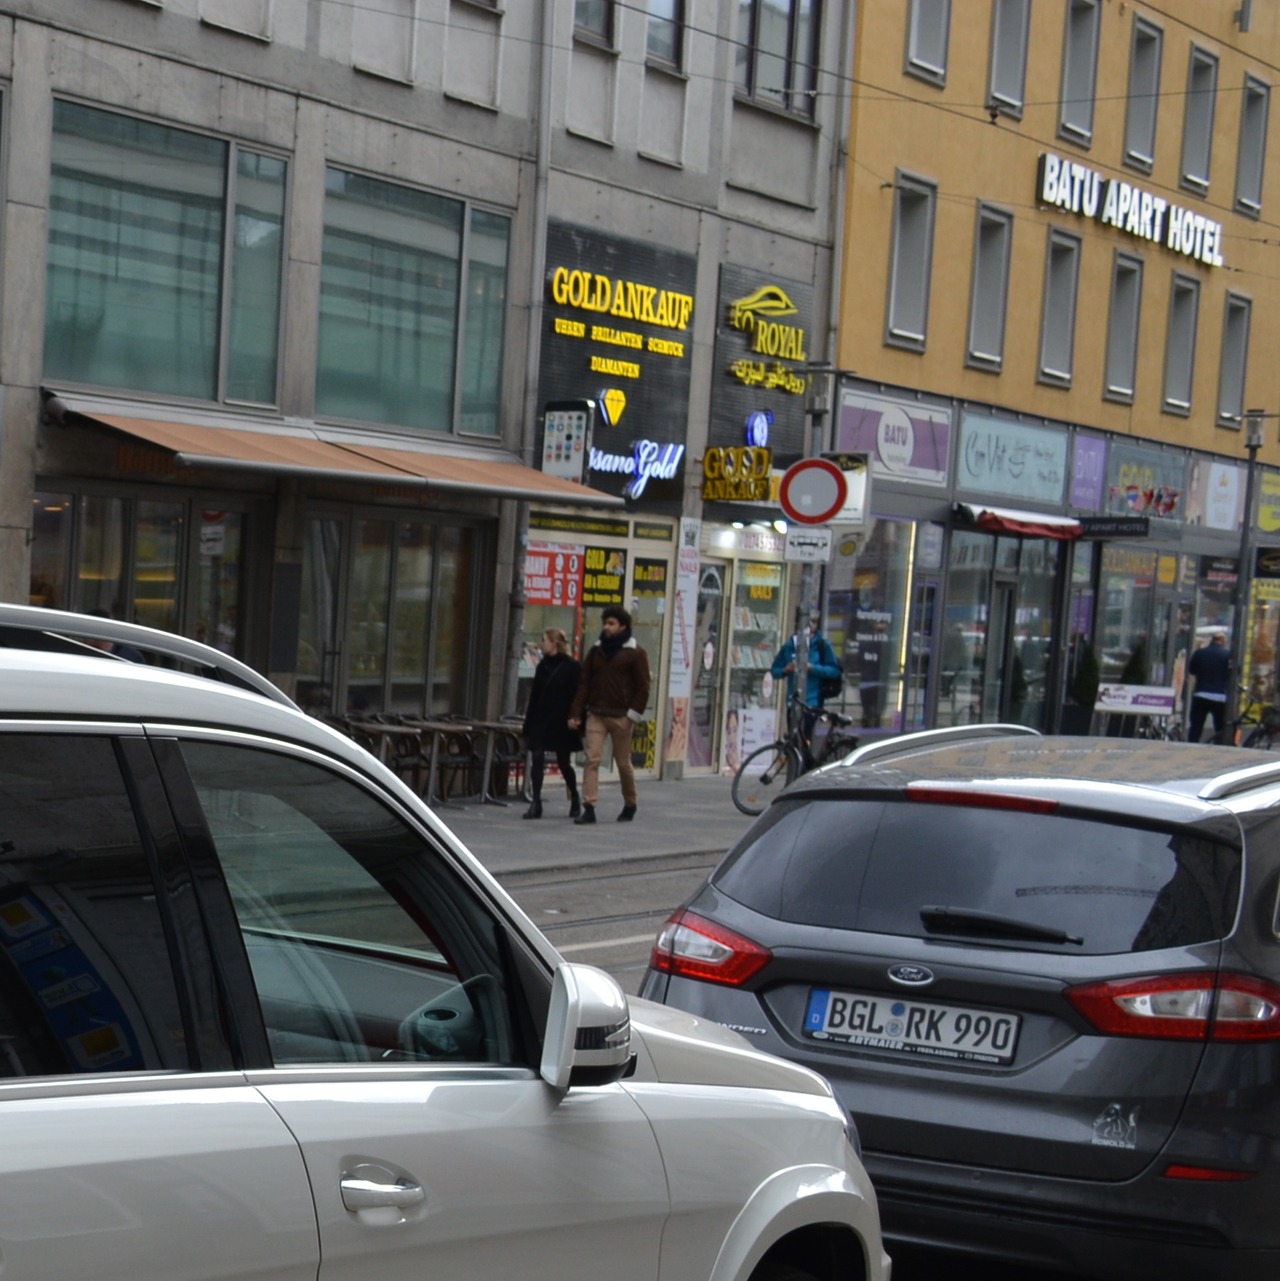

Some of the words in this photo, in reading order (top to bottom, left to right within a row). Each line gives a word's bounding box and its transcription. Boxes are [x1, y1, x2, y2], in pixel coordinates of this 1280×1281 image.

[1042, 153, 1102, 217] BATU
[1101, 178, 1167, 243] APART
[1167, 204, 1223, 267] HOTEL
[591, 325, 643, 350] BRILLANTEN
[756, 319, 806, 361] ROYAL
[591, 356, 640, 379] DIAMANTEN
[884, 423, 908, 447] BATU
[630, 439, 684, 500] Gold
[811, 1013, 820, 1024] D
[828, 997, 884, 1035] BGL
[905, 1007, 947, 1043] RK
[953, 1013, 1012, 1051] 990
